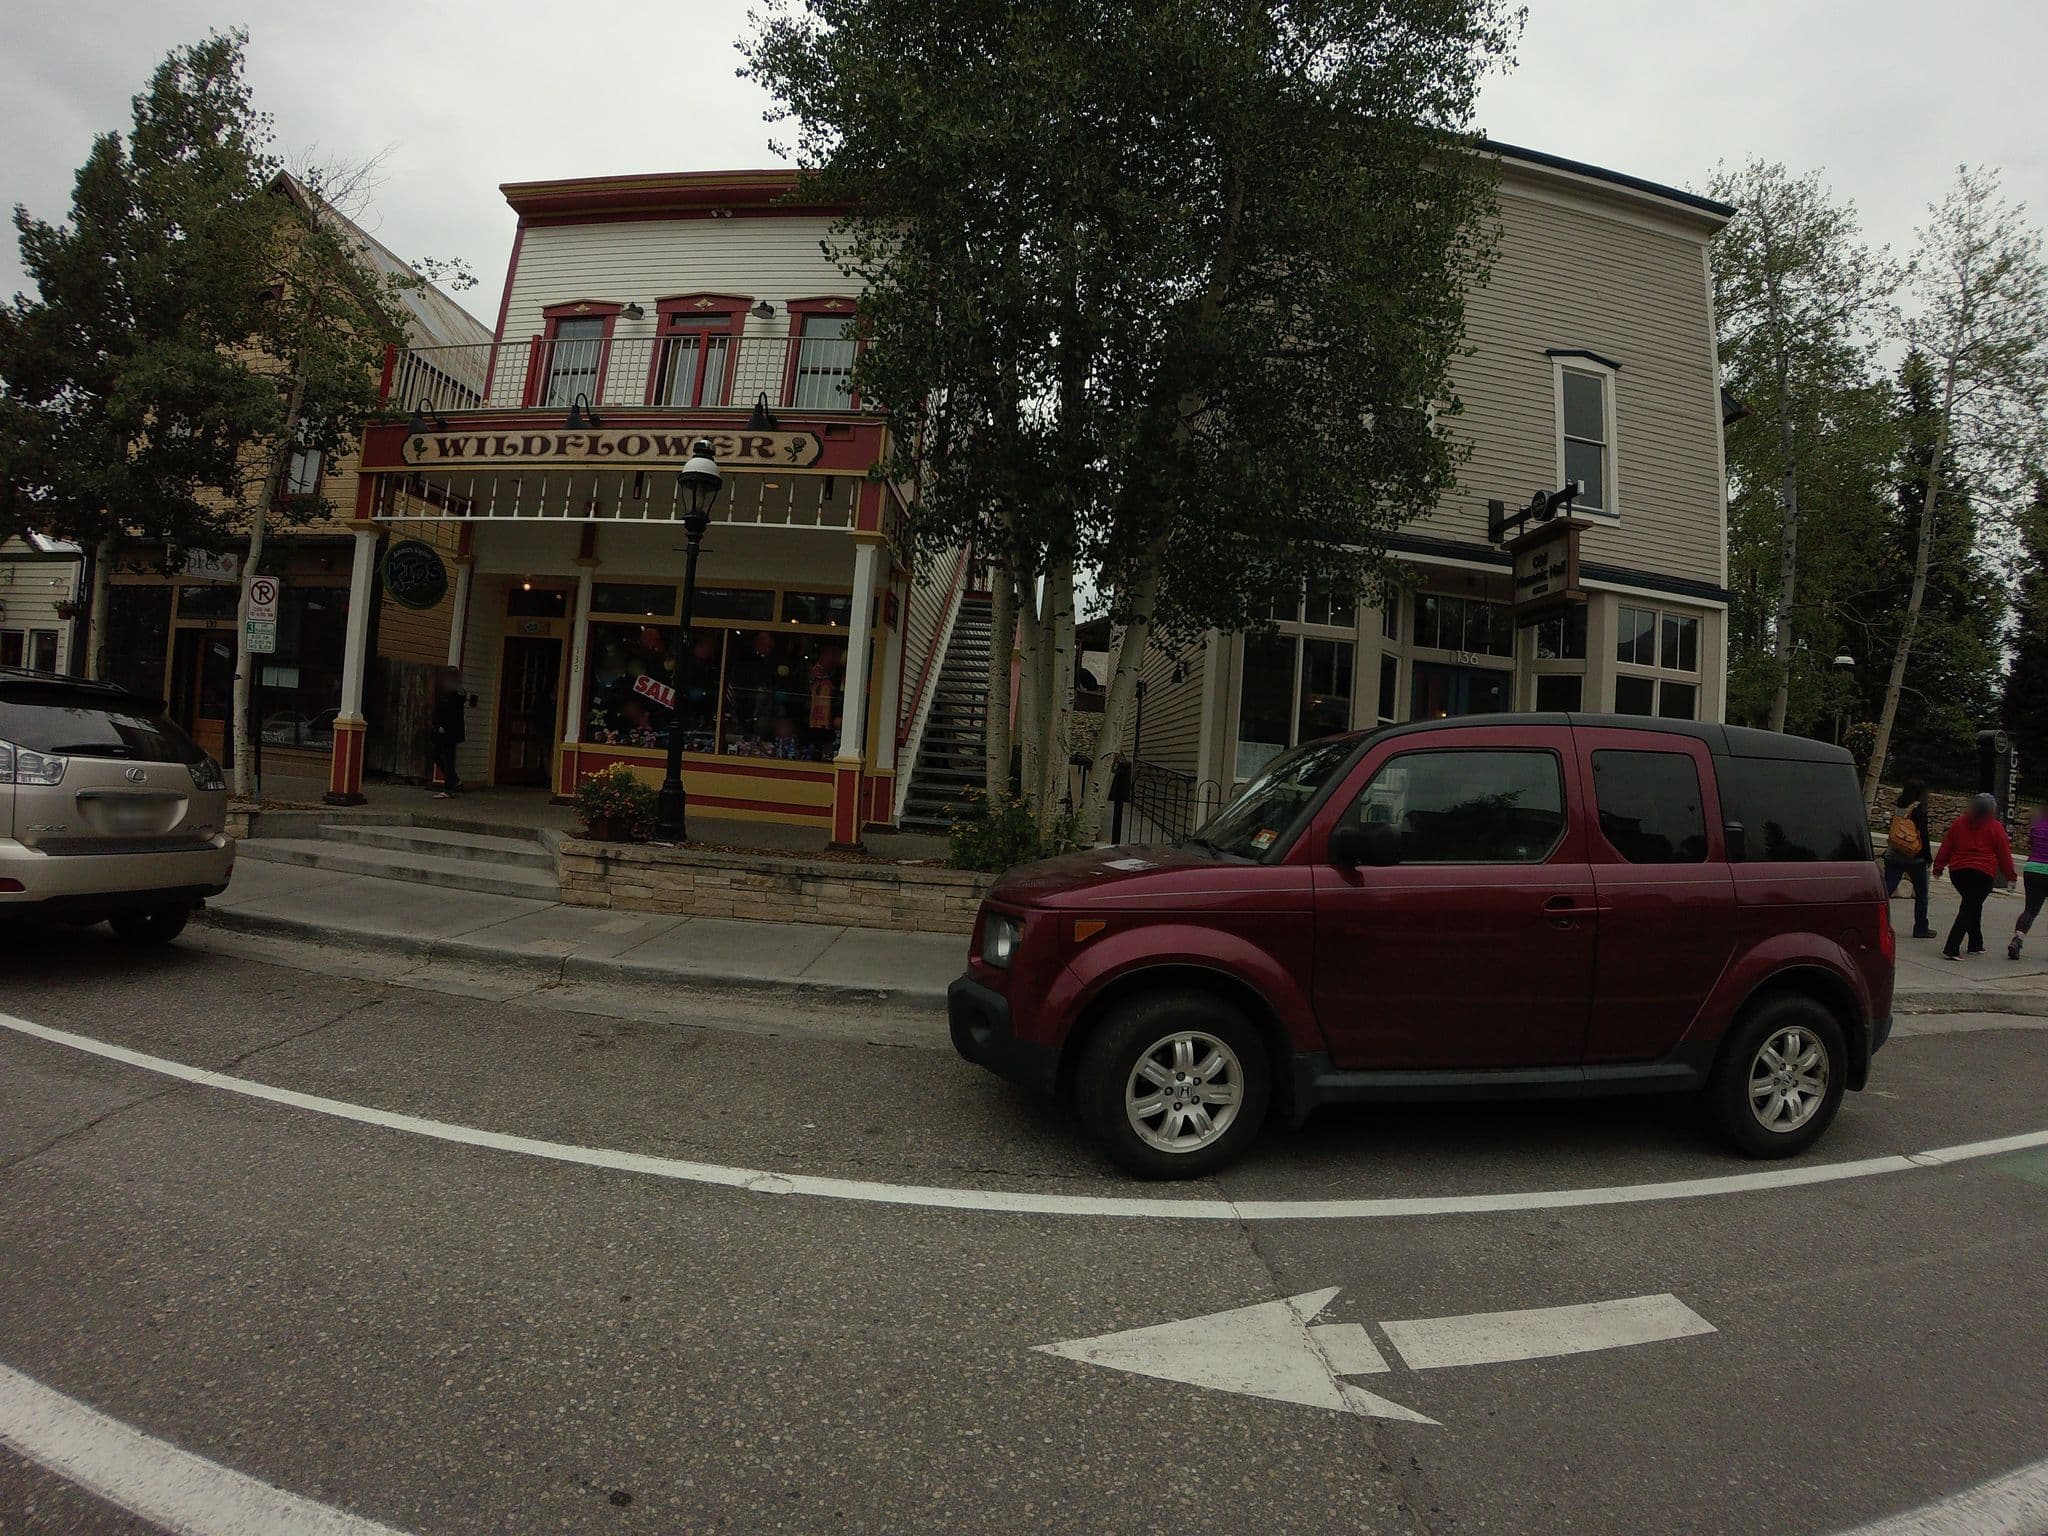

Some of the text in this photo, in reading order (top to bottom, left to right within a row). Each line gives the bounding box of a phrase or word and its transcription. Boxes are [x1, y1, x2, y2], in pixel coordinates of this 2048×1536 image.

[434, 433, 777, 460] WILDFLOWER
[248, 623, 255, 633] 3
[1455, 650, 1479, 665] 136
[635, 676, 675, 706] SAL
[2007, 749, 2019, 820] DISTRICT
